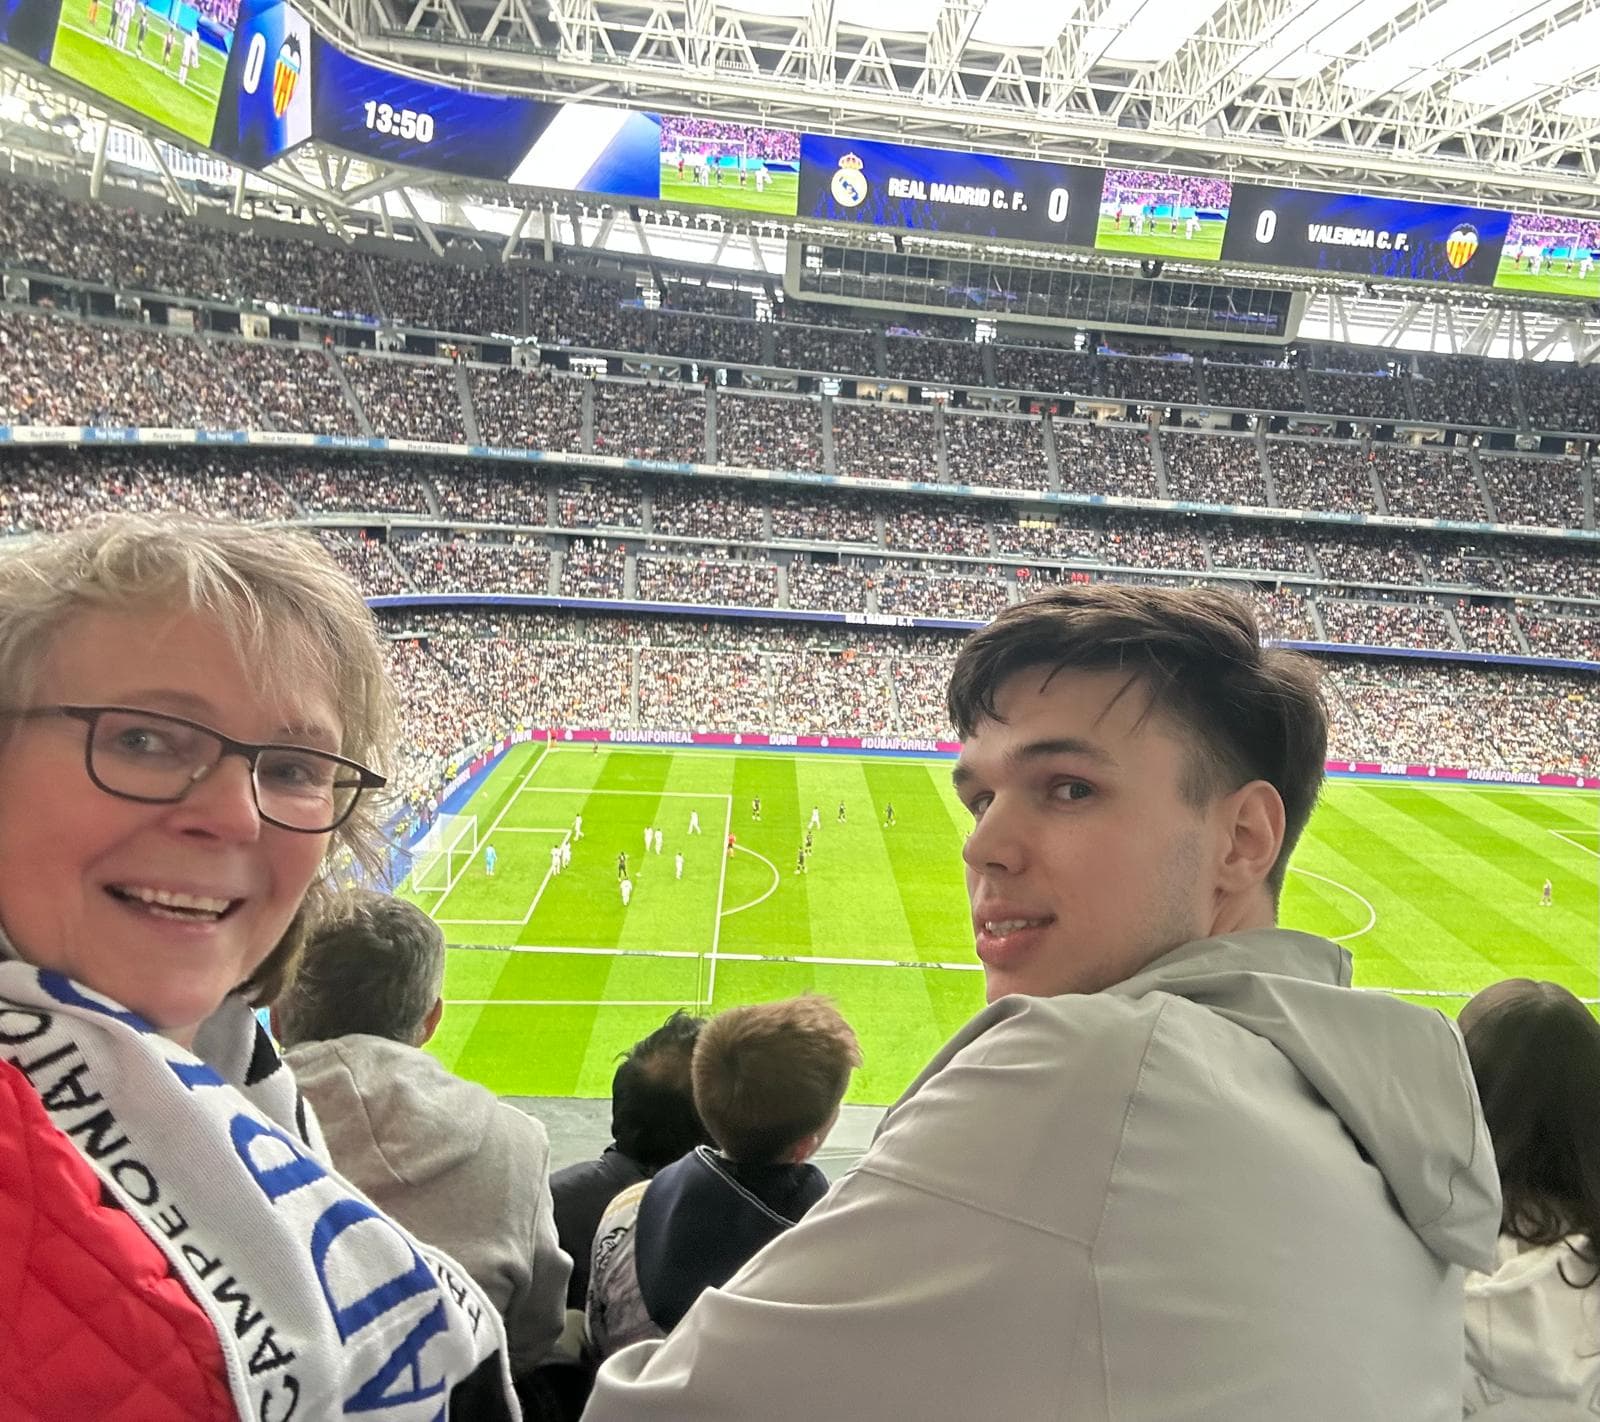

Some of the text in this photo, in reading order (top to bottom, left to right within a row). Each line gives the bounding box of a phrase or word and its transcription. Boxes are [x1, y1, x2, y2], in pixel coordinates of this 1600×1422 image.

[243, 32, 266, 94] 0
[364, 100, 434, 143] 13:50
[888, 177, 1069, 222] REAL MADRID C. F. 0
[1255, 209, 1409, 251] 0 VALENCIA C. F.
